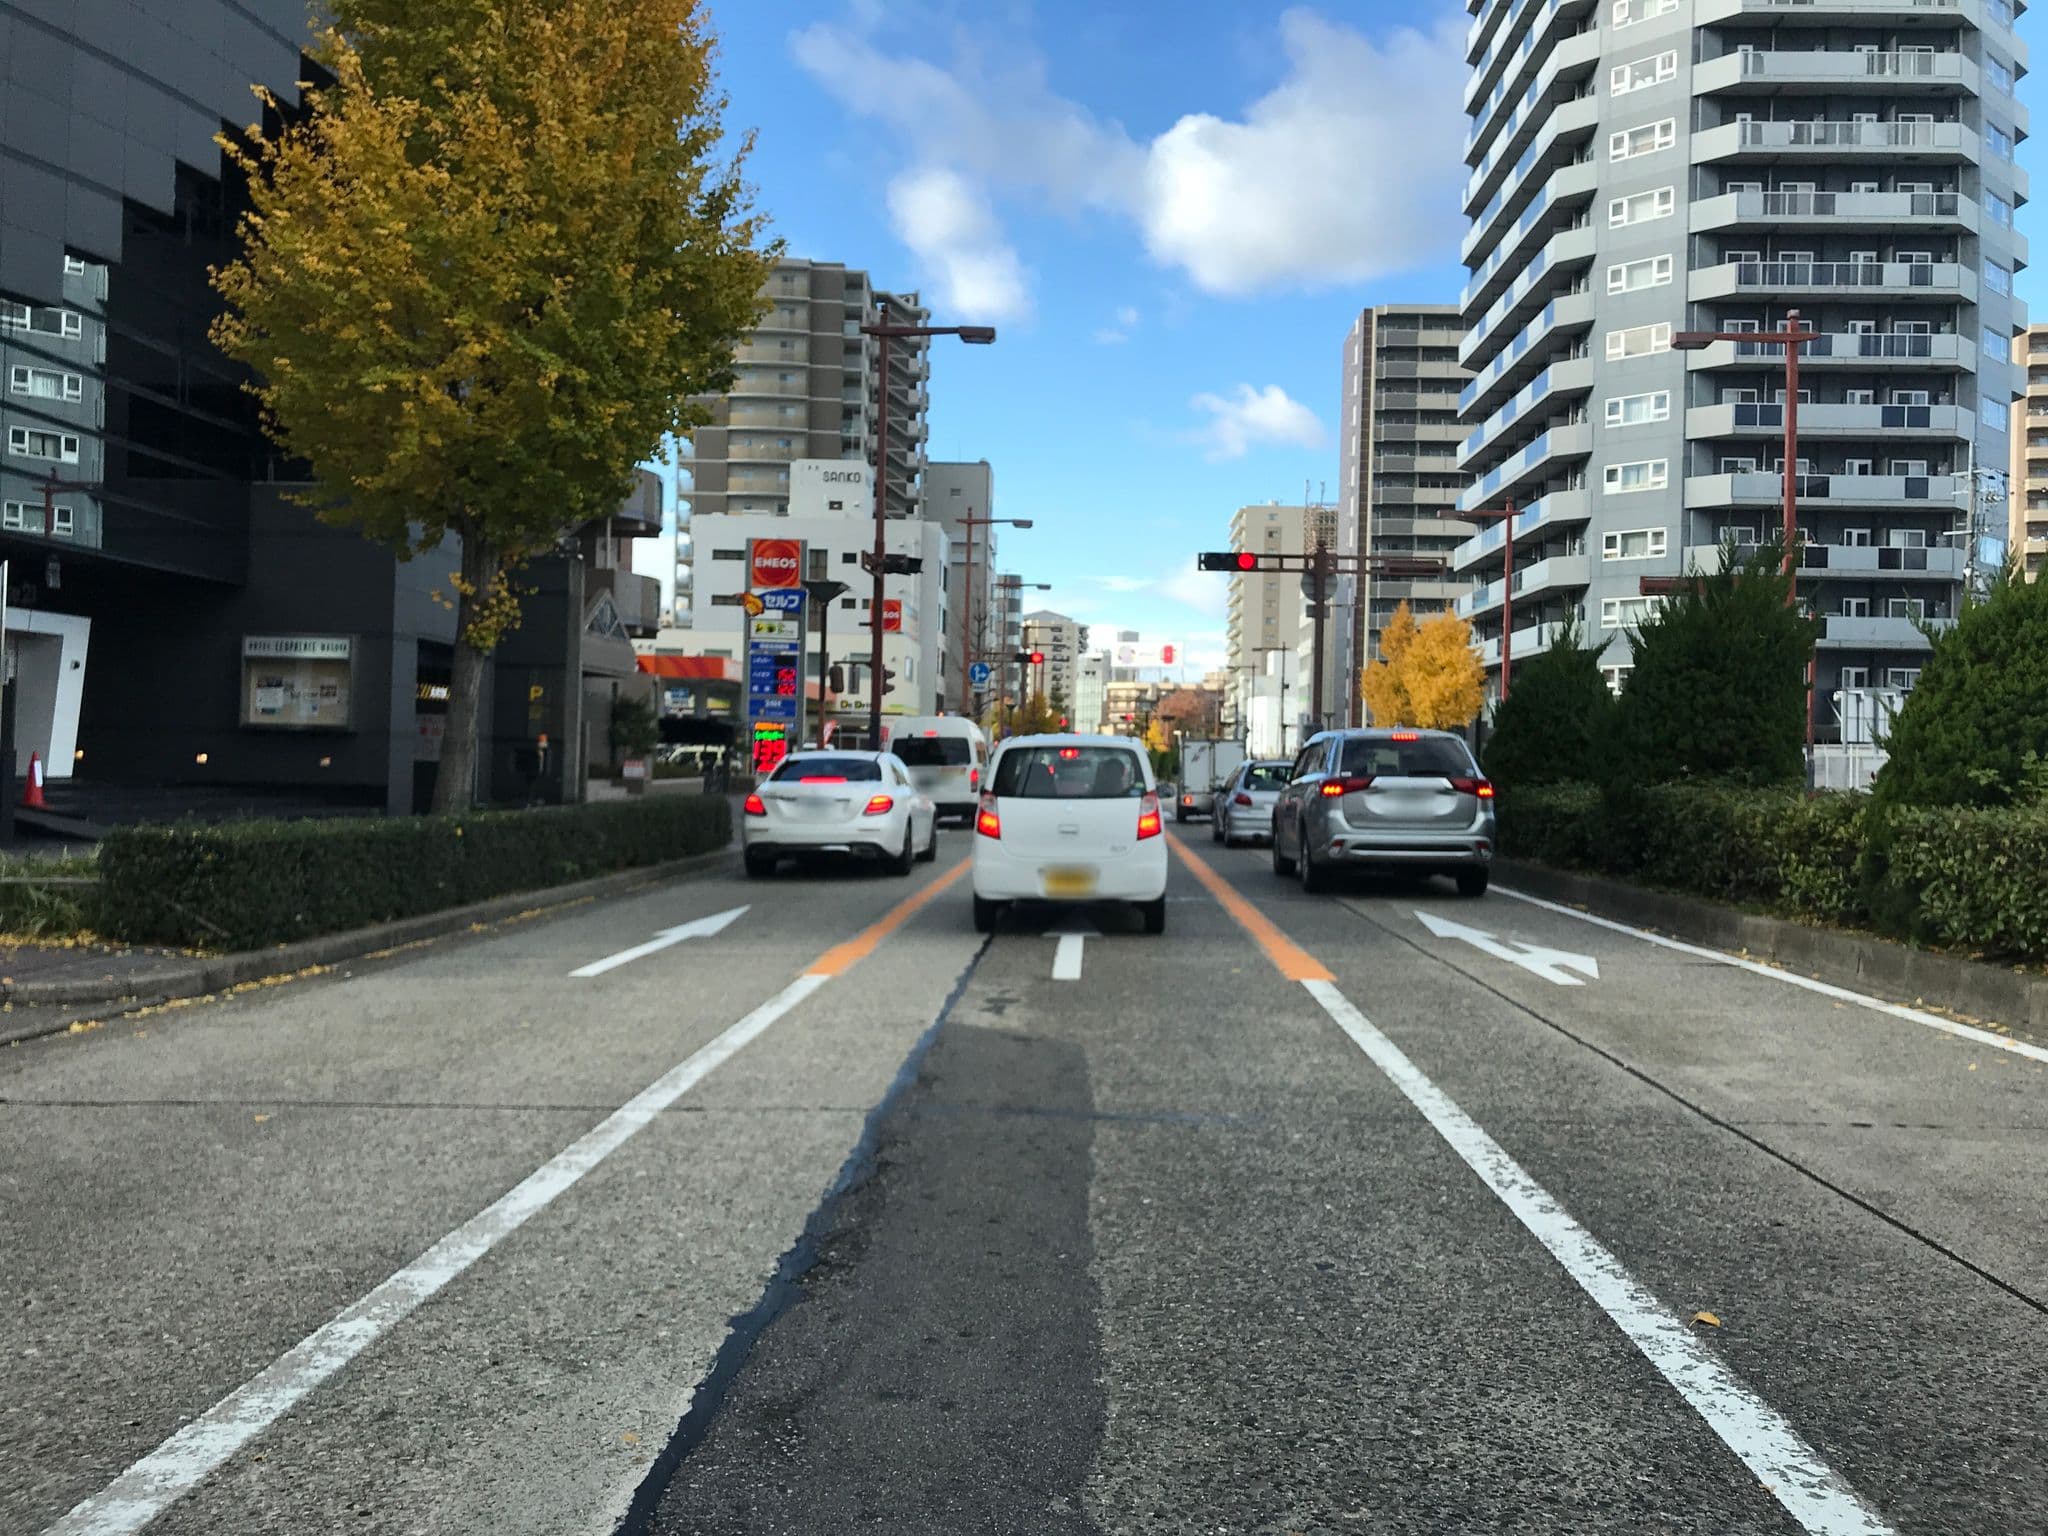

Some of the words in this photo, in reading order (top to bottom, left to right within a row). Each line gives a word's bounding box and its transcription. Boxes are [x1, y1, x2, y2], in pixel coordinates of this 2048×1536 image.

[823, 471, 861, 483] SANKO
[755, 557, 797, 569] ENEOS
[764, 594, 800, 608] セルフ
